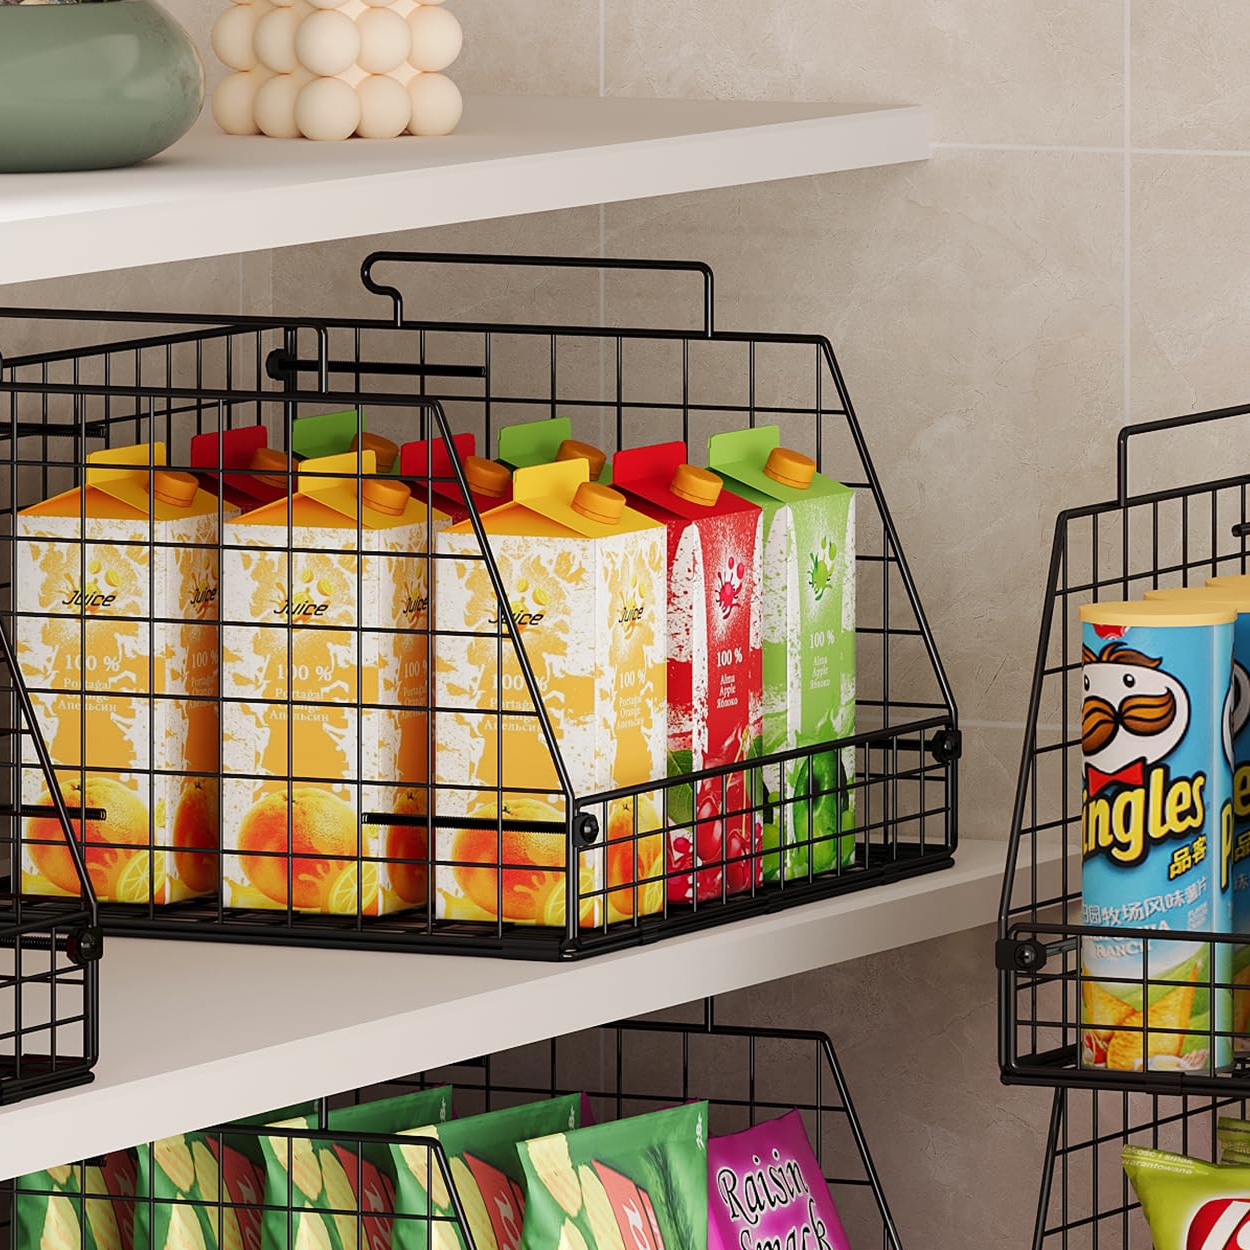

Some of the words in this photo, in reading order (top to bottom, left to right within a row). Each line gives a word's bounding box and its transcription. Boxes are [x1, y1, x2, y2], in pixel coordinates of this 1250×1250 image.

[618, 607, 644, 623] Juice
[809, 631, 825, 649] 100
[717, 649, 732, 667] 100
[734, 647, 743, 664] %
[1168, 835, 1207, 880] 品客
[717, 1149, 810, 1226] Raisin
